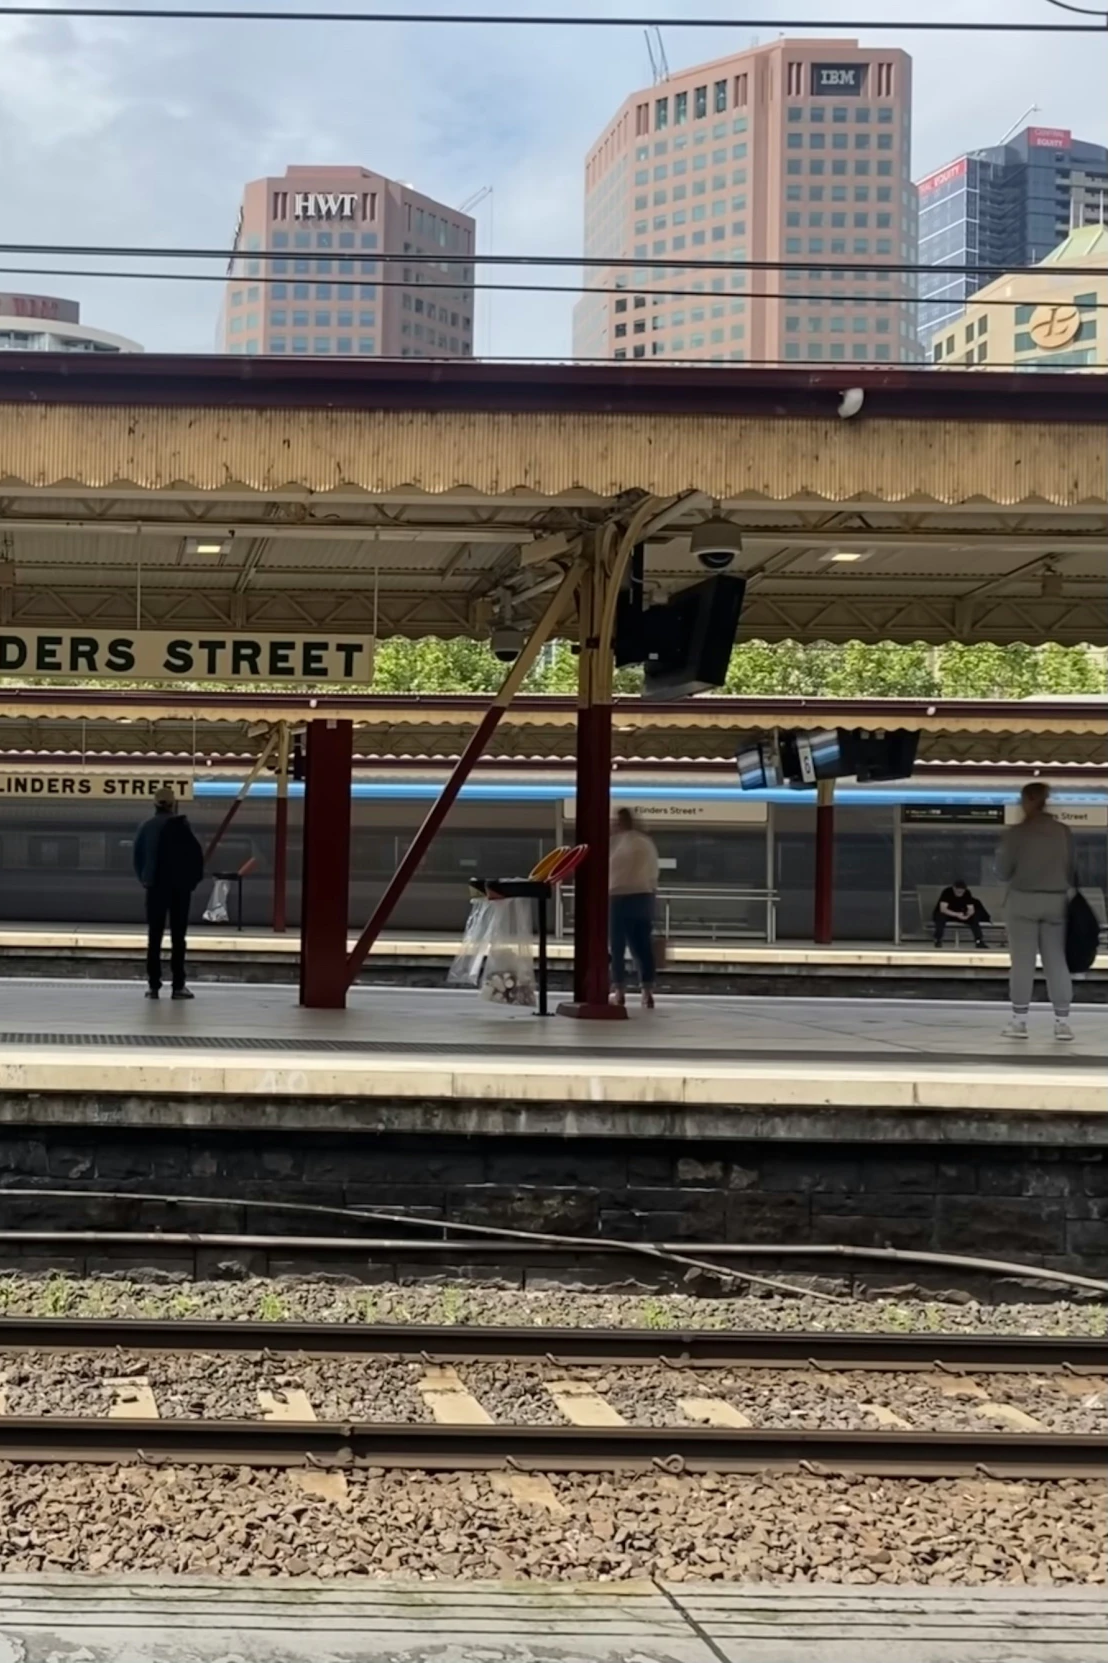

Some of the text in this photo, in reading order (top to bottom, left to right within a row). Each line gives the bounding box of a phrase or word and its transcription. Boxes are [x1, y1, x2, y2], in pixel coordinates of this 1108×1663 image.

[821, 69, 855, 85] IBM
[1036, 137, 1063, 147] EQUITY
[933, 166, 960, 187] EQUITY
[294, 193, 358, 216] HWT
[163, 639, 364, 678] STREET
[634, 806, 696, 815] Flinders Street
[1061, 812, 1088, 820] Street
